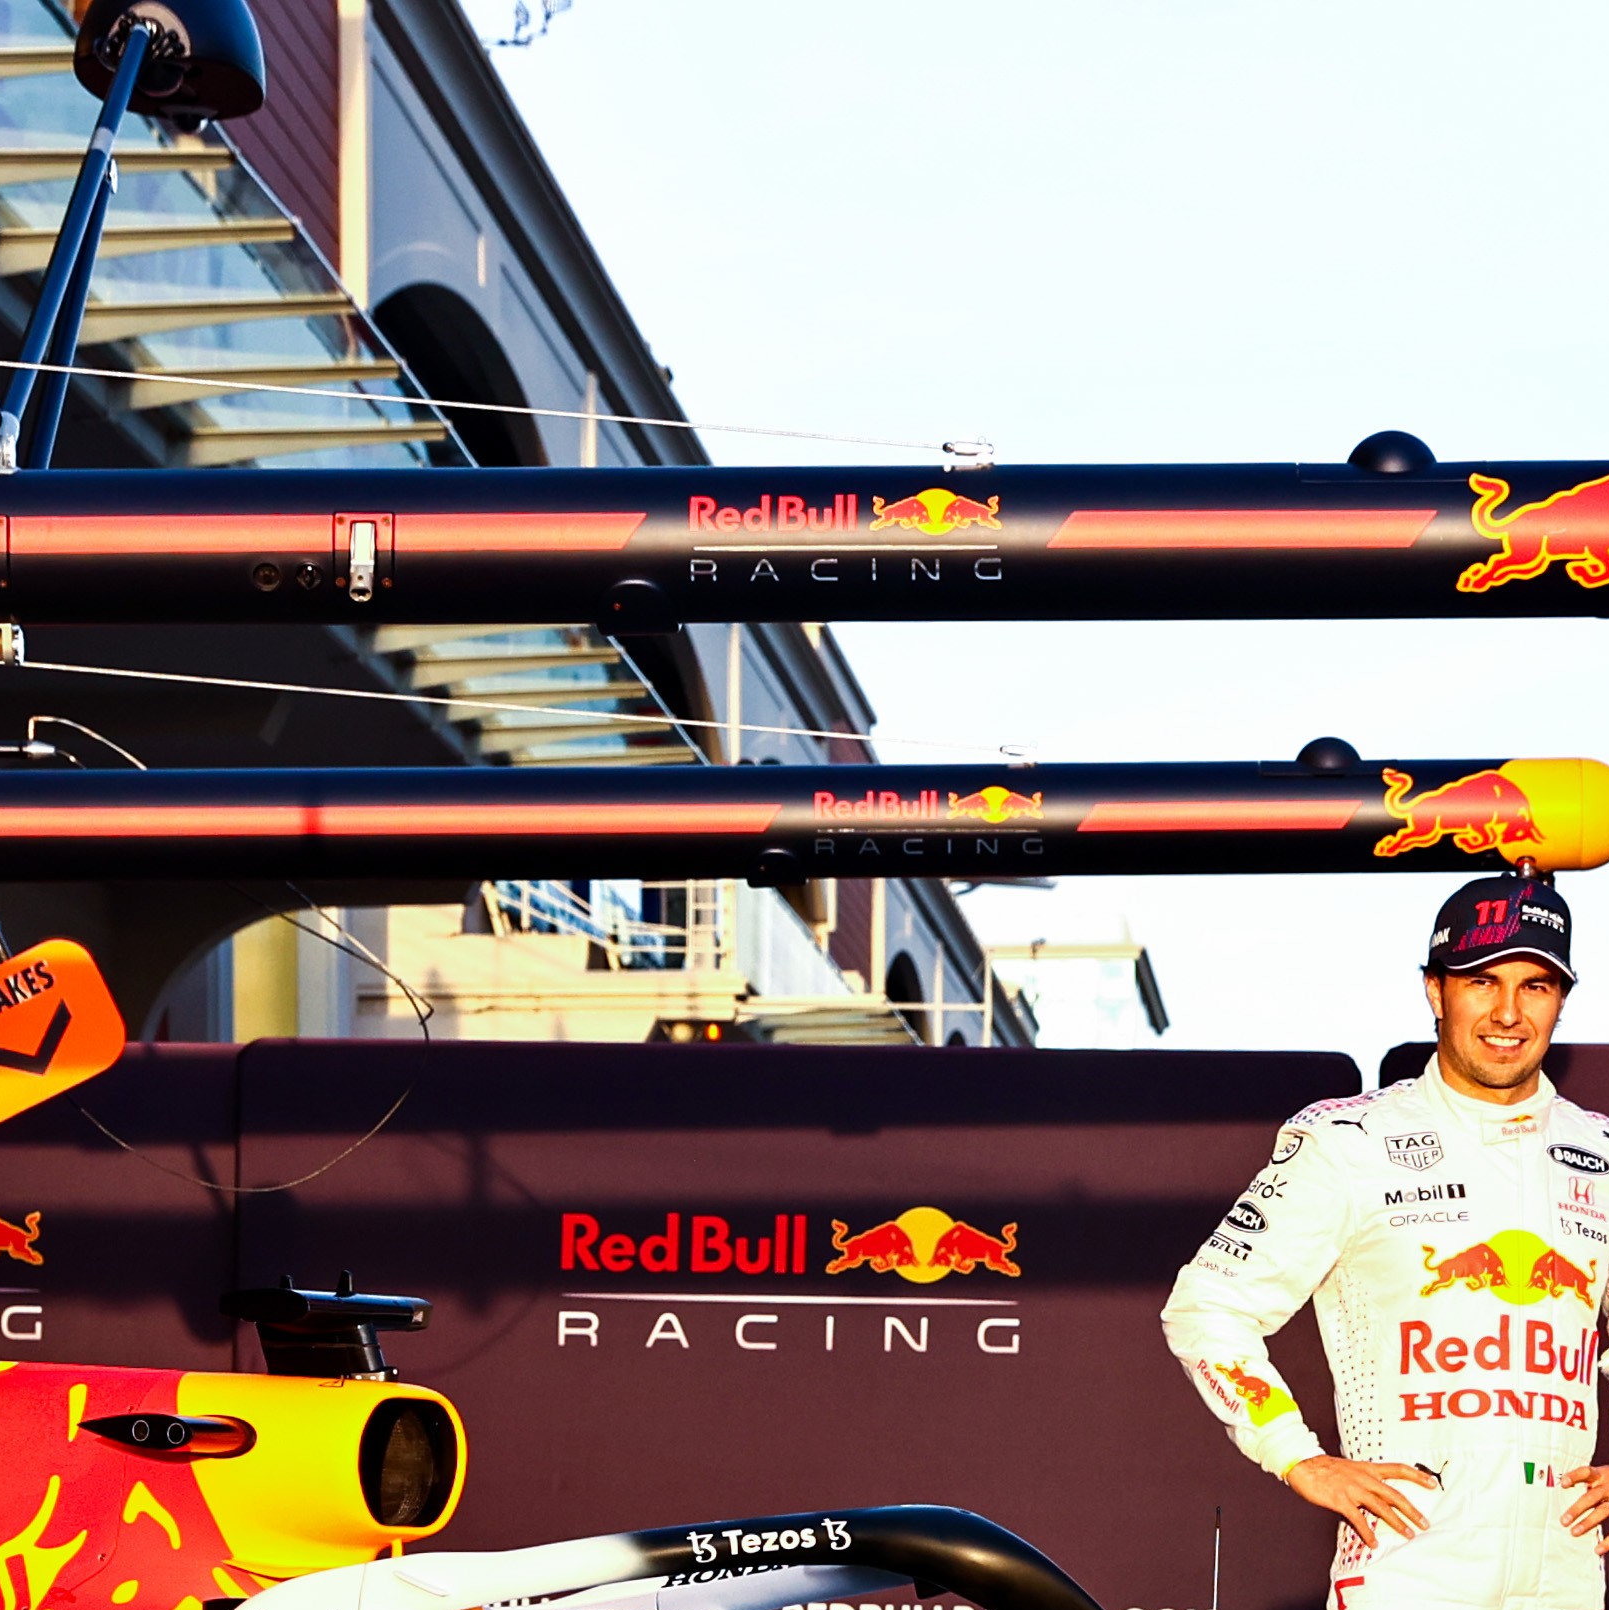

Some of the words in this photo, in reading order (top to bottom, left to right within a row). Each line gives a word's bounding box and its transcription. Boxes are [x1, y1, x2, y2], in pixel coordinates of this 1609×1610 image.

[690, 494, 771, 532] Red
[777, 494, 858, 532] Bull
[690, 558, 1002, 581] RACING
[813, 789, 876, 820] Red
[879, 789, 939, 820] Bull
[814, 838, 1044, 856] RACING
[1475, 899, 1509, 926] 11
[1501, 1125, 1519, 1136] Red
[1520, 1122, 1538, 1135] Bull
[1390, 1133, 1436, 1150] TAG
[1391, 1149, 1440, 1169] HEUER
[1562, 1149, 1607, 1172] RAUCH
[1384, 1185, 1444, 1205] Mobil
[1390, 1211, 1469, 1227] ORACLE
[1557, 1202, 1607, 1223] HONDA
[561, 1212, 679, 1273] Red
[691, 1214, 806, 1274] Bull
[1575, 1221, 1608, 1245] Tezos
[558, 1311, 1021, 1354] RACING
[1400, 1314, 1511, 1375] Red
[1525, 1319, 1600, 1386] Bull
[1196, 1360, 1219, 1391] Red
[1215, 1385, 1240, 1414] Bull
[1399, 1389, 1588, 1431] HONDA
[722, 1526, 817, 1556] Tezos
